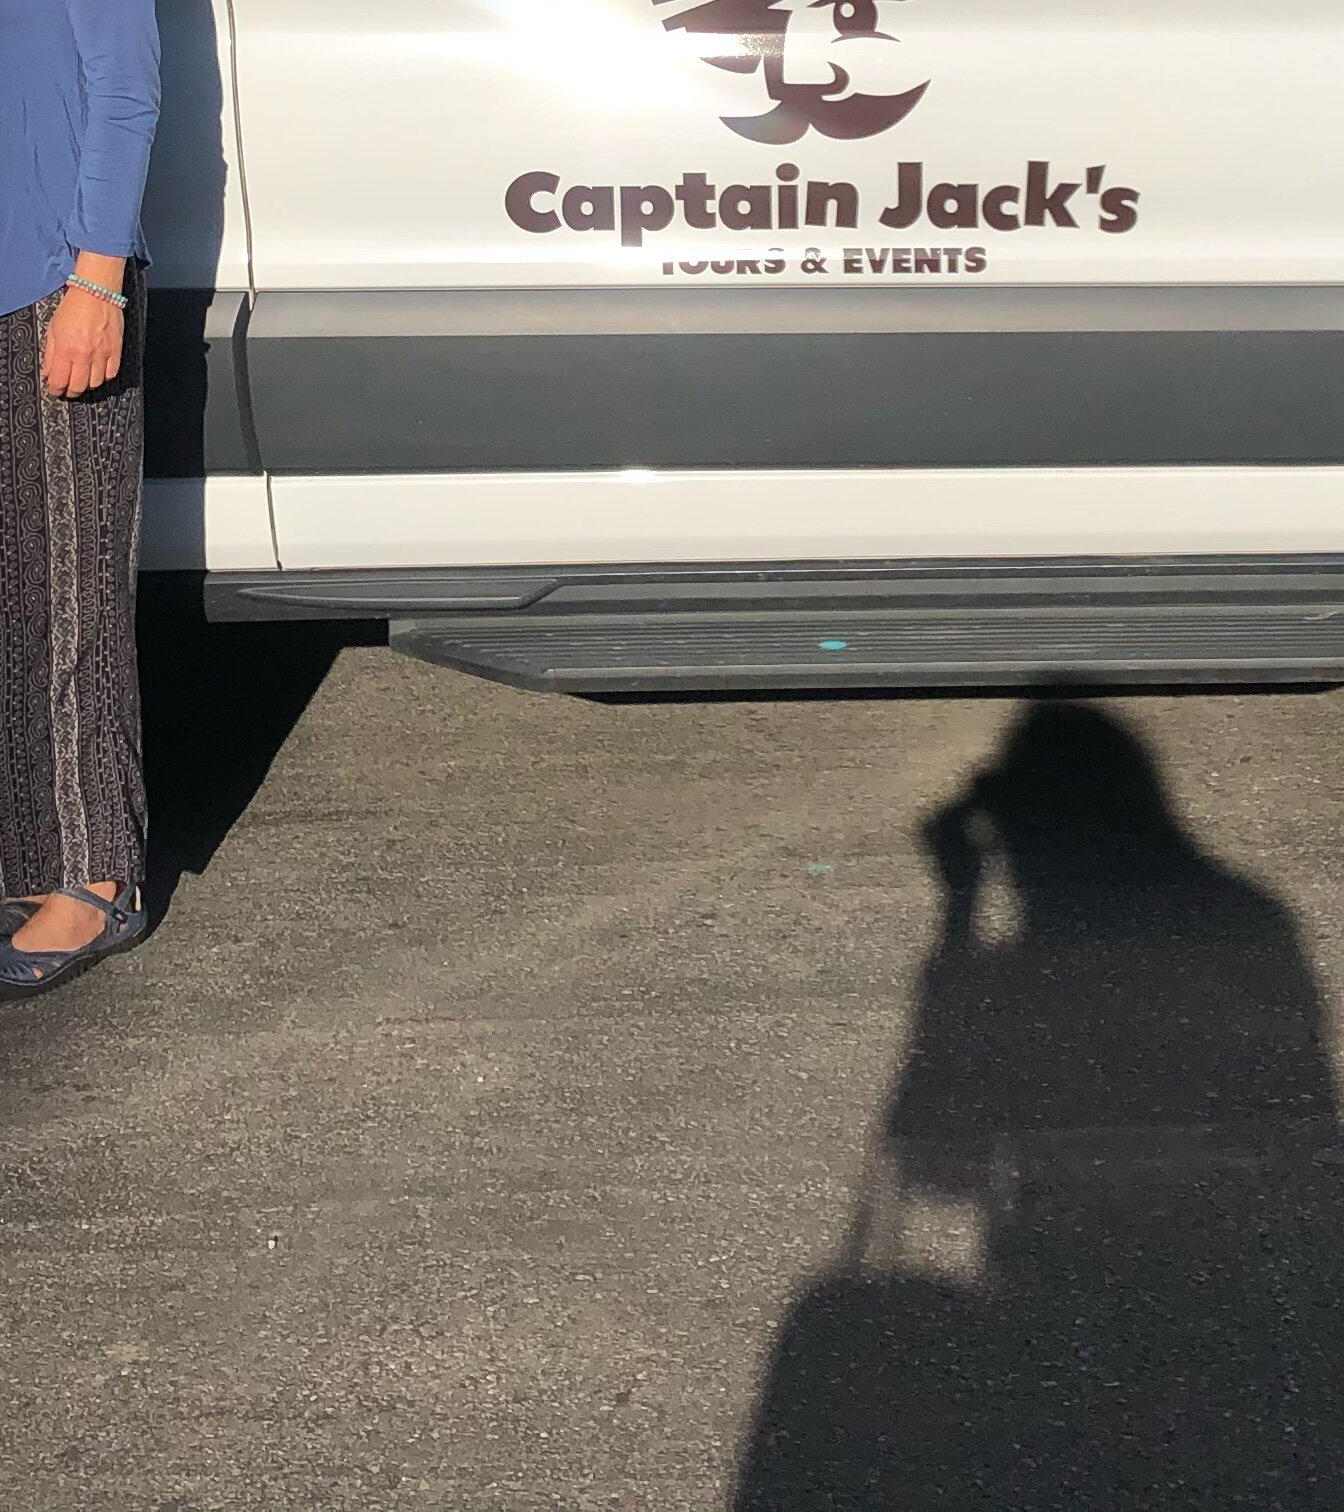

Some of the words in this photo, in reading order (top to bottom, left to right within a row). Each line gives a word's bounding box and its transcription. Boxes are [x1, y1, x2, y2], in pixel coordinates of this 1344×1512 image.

[504, 162, 858, 247] Captain
[878, 160, 1141, 234] Jack's
[800, 247, 829, 274] &
[842, 246, 988, 274] EVENTS
